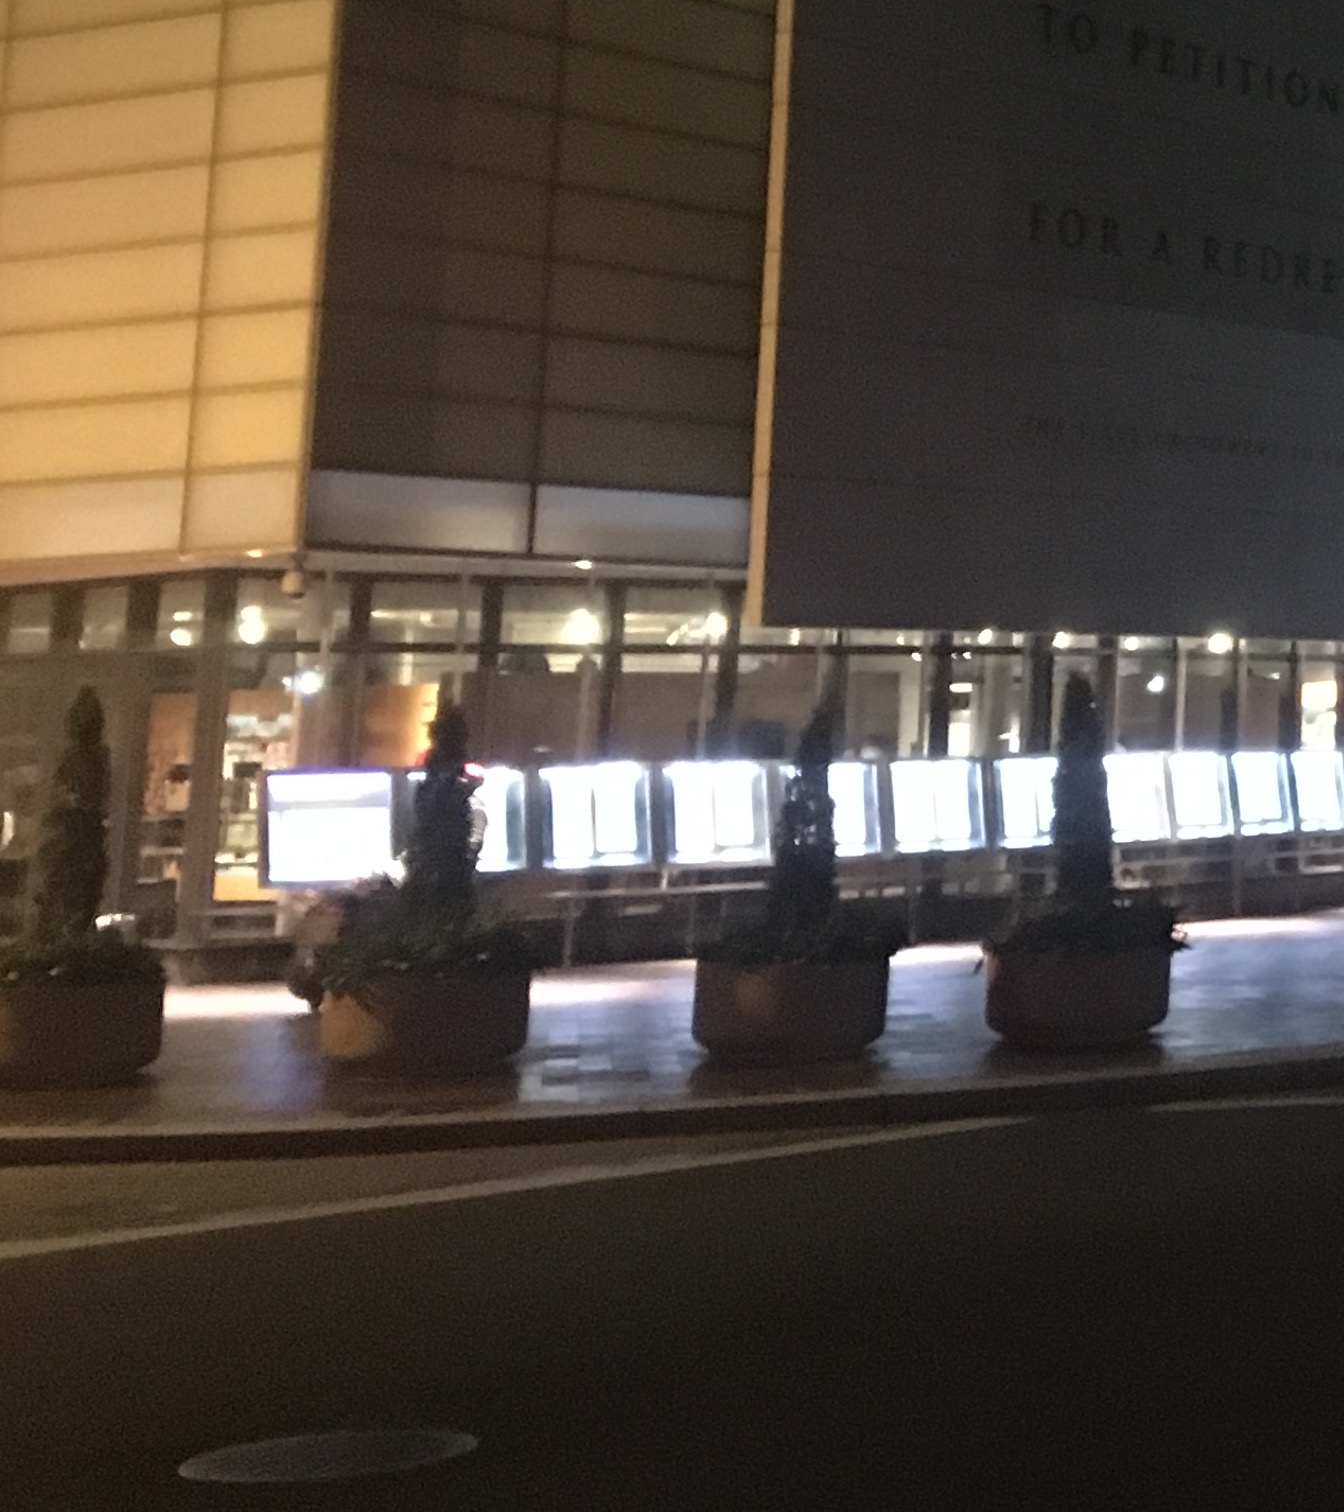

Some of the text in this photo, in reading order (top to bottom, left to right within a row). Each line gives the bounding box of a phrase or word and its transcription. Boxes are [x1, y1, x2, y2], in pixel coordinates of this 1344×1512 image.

[1033, 1, 1100, 55] TO
[1127, 26, 1343, 117] PETITION
[1027, 200, 1125, 257] FOR
[1150, 224, 1173, 264] A
